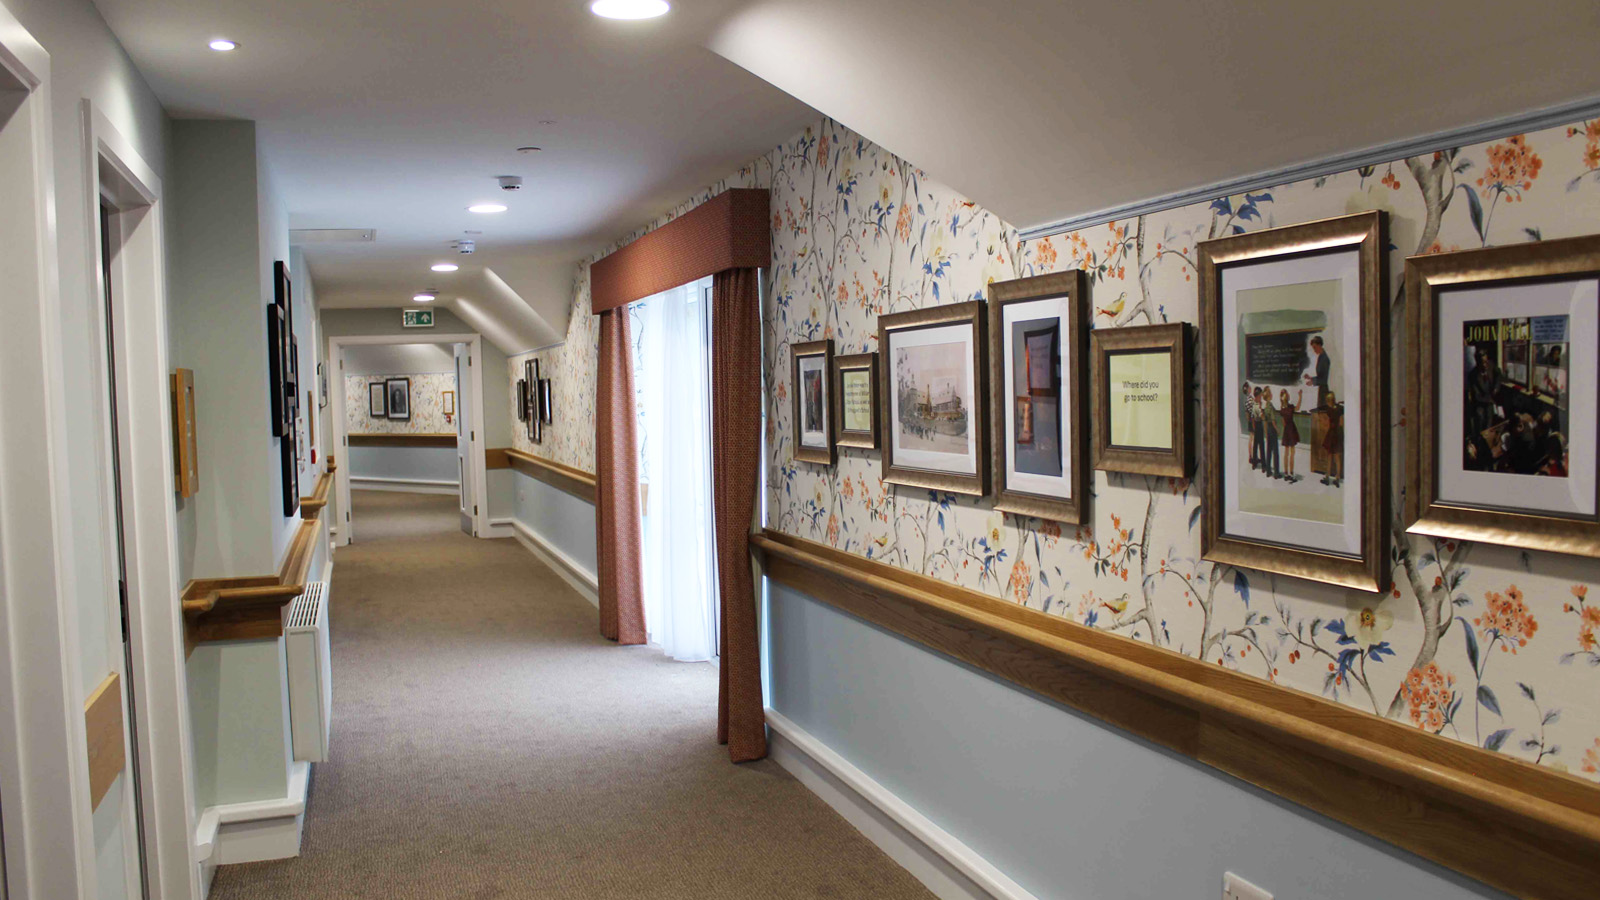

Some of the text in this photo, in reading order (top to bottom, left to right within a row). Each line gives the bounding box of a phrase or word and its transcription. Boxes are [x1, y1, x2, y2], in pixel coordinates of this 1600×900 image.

[1466, 325, 1498, 342] JOHN
[1502, 324, 1532, 341] BULL
[1122, 380, 1159, 390] Where did you
[1124, 393, 1158, 403] go to school?
